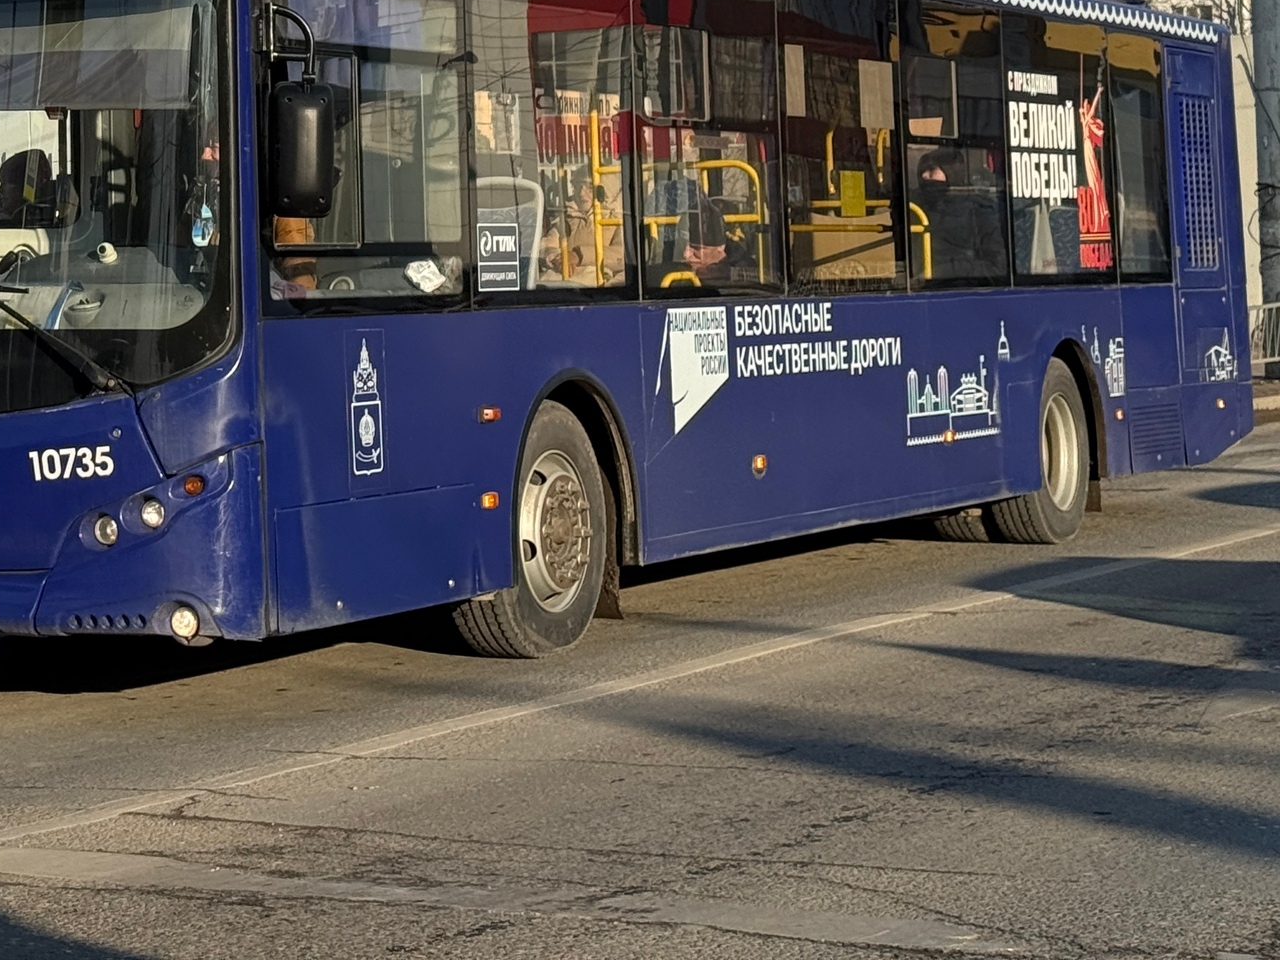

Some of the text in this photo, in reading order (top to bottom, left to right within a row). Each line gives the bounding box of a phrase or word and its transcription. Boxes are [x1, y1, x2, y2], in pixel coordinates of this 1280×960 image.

[1014, 71, 1058, 97] ПРАЗДНИКОМ
[1008, 100, 1077, 150] ВЕЛИКОЙ
[1010, 152, 1078, 207] ПОБЕДЫ!
[492, 235, 516, 253] ГТЛК
[669, 309, 726, 333] НАЦИОНАЛЬНЫЕ
[734, 301, 833, 338] БЕЗОПАСНЫЕ
[693, 332, 726, 354] ПРОЕКТЫ
[735, 336, 902, 379] КАЧЕСТВЕННЫЕ ДОРОГИ
[700, 355, 727, 377] РОССИИ
[28, 444, 115, 482] 10735
